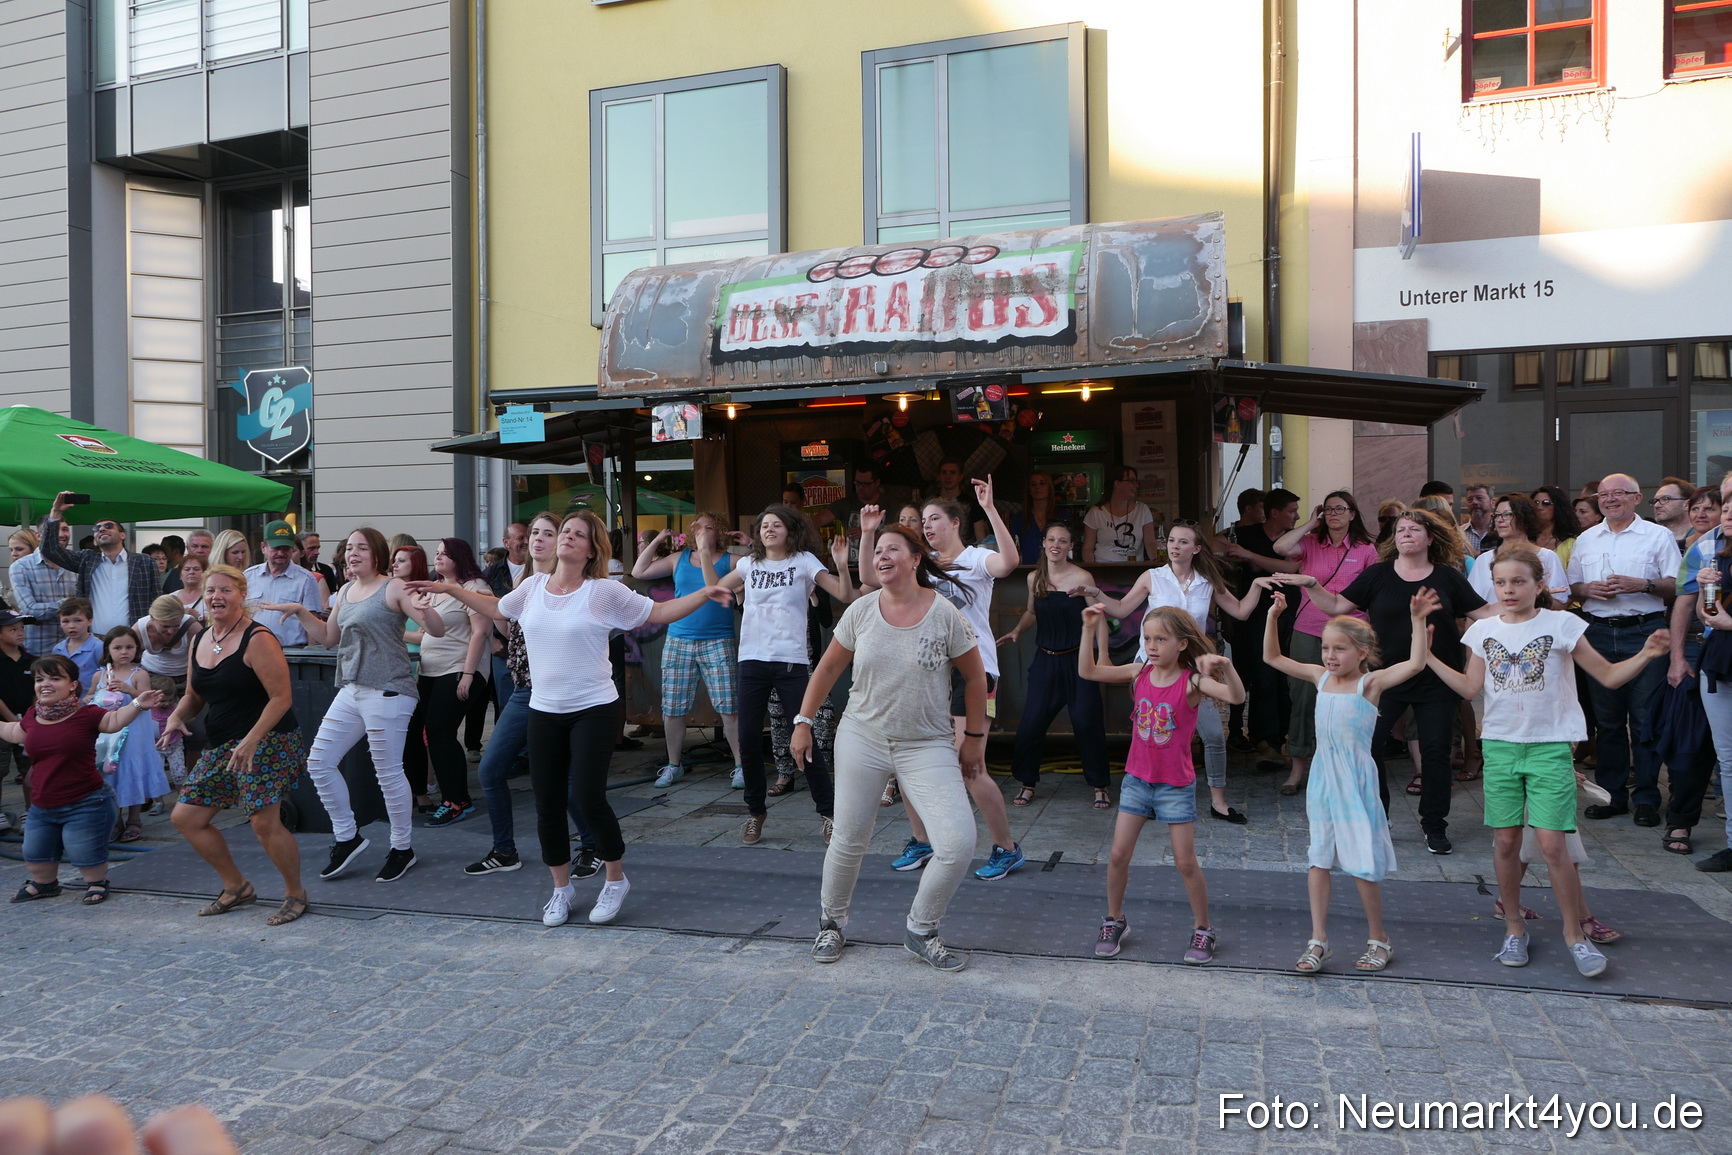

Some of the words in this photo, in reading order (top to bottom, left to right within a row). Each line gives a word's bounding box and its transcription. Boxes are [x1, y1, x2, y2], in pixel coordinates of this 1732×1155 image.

[1399, 288, 1468, 307] Unterer
[1473, 282, 1526, 302] Markt
[1533, 279, 1555, 298] 15
[258, 386, 295, 441] G2
[1051, 443, 1086, 452] Heineken
[1113, 521, 1136, 549] 3
[750, 566, 797, 590] STREET
